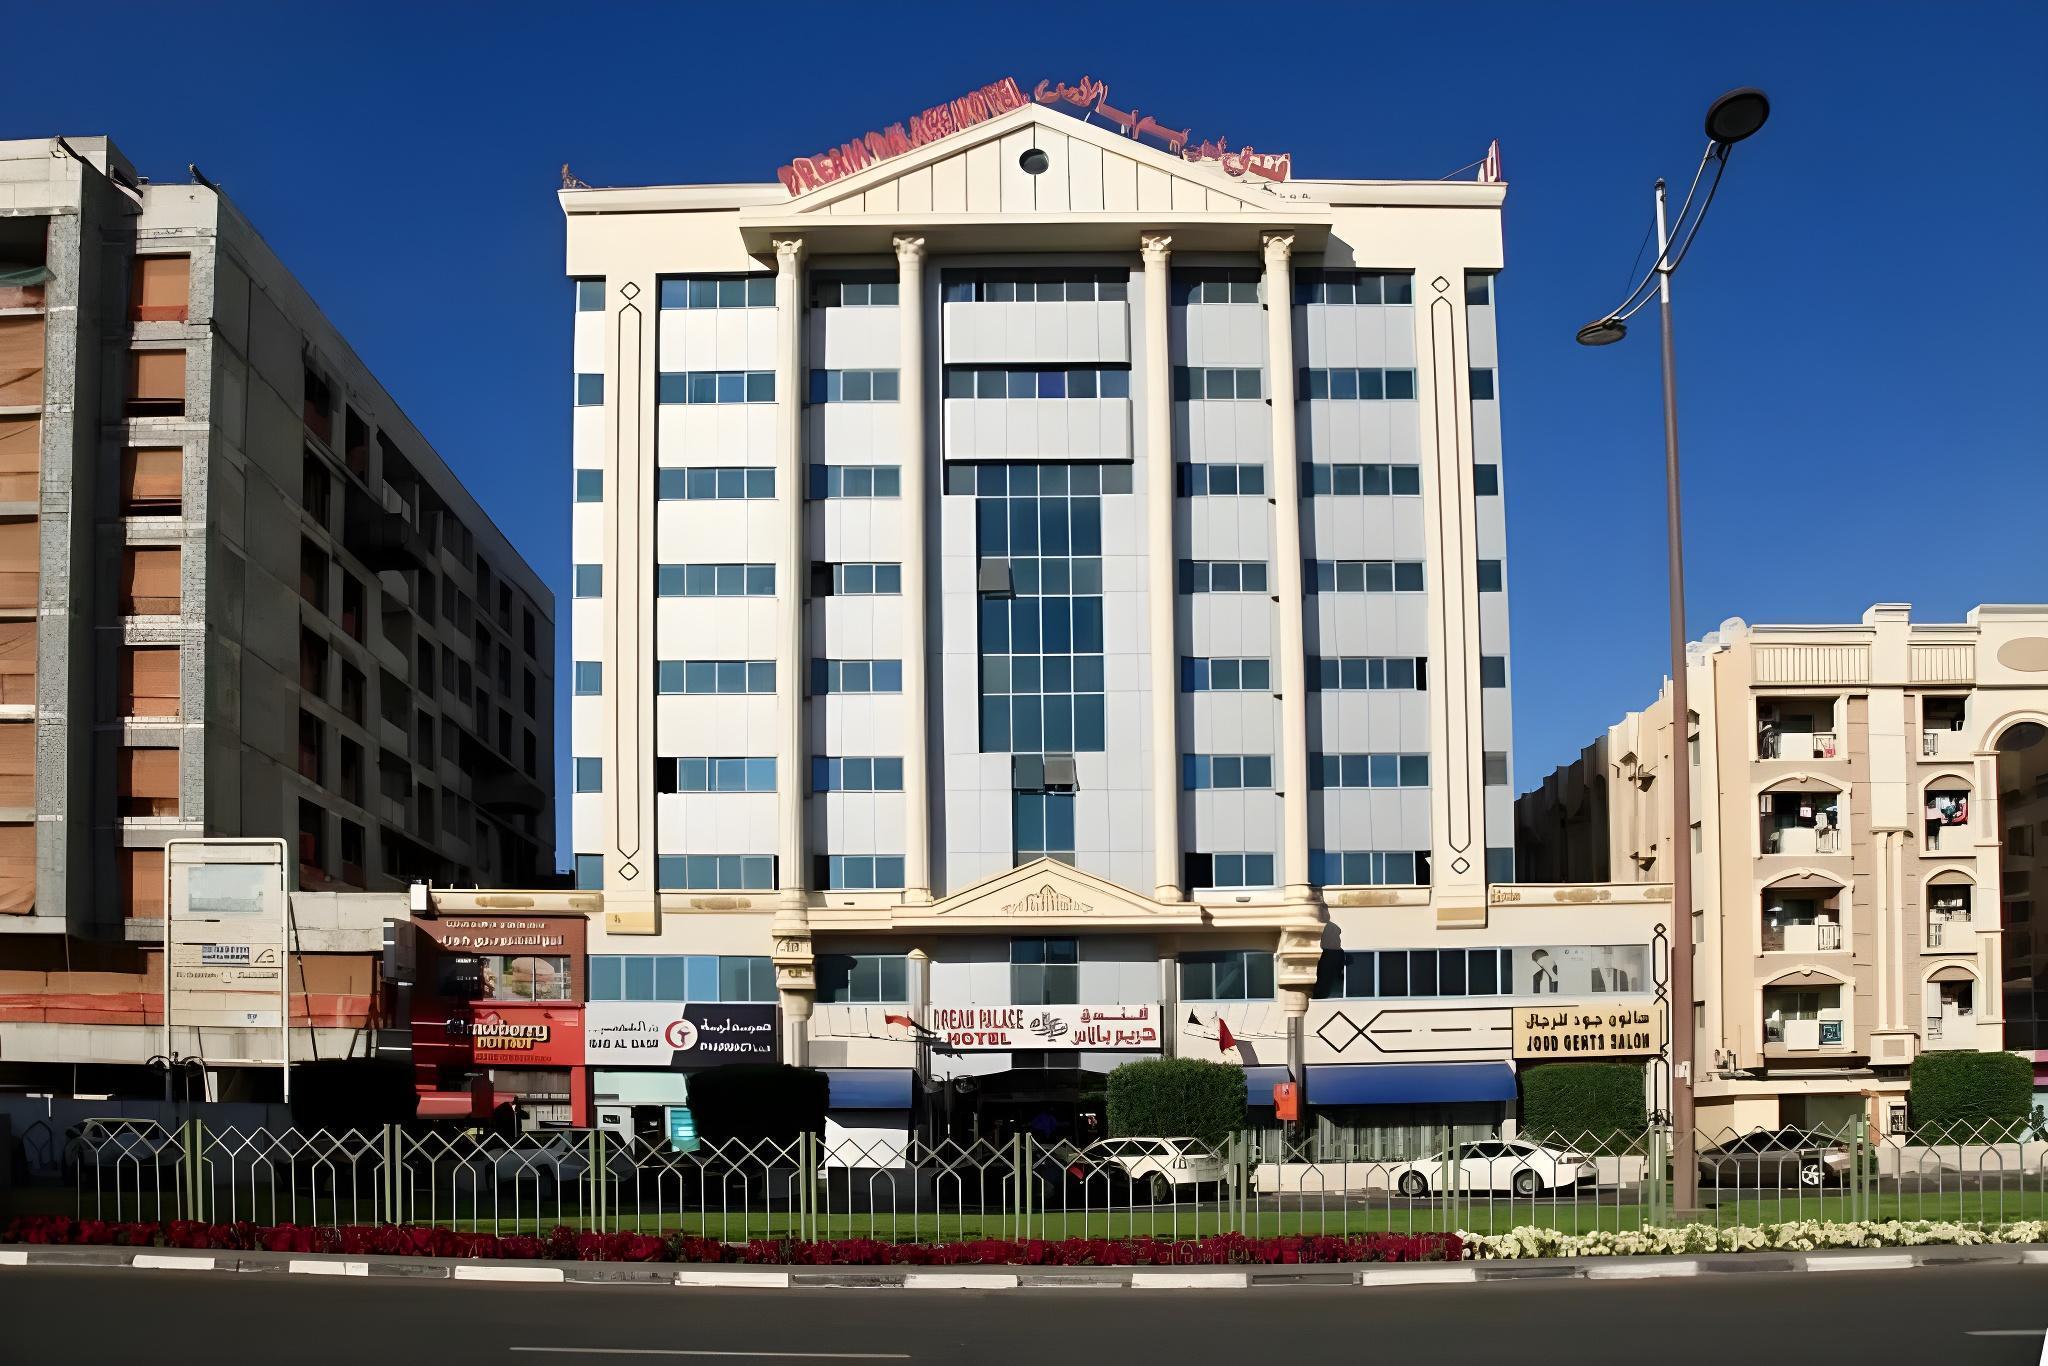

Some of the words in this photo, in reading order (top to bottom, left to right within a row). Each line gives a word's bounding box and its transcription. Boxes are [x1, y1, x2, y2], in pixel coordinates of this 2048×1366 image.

[934, 1009, 975, 1030] DREAM
[946, 1032, 1012, 1046] HOTEL
[1526, 1035, 1559, 1052] JOOD
[1610, 1032, 1650, 1050] SALON
